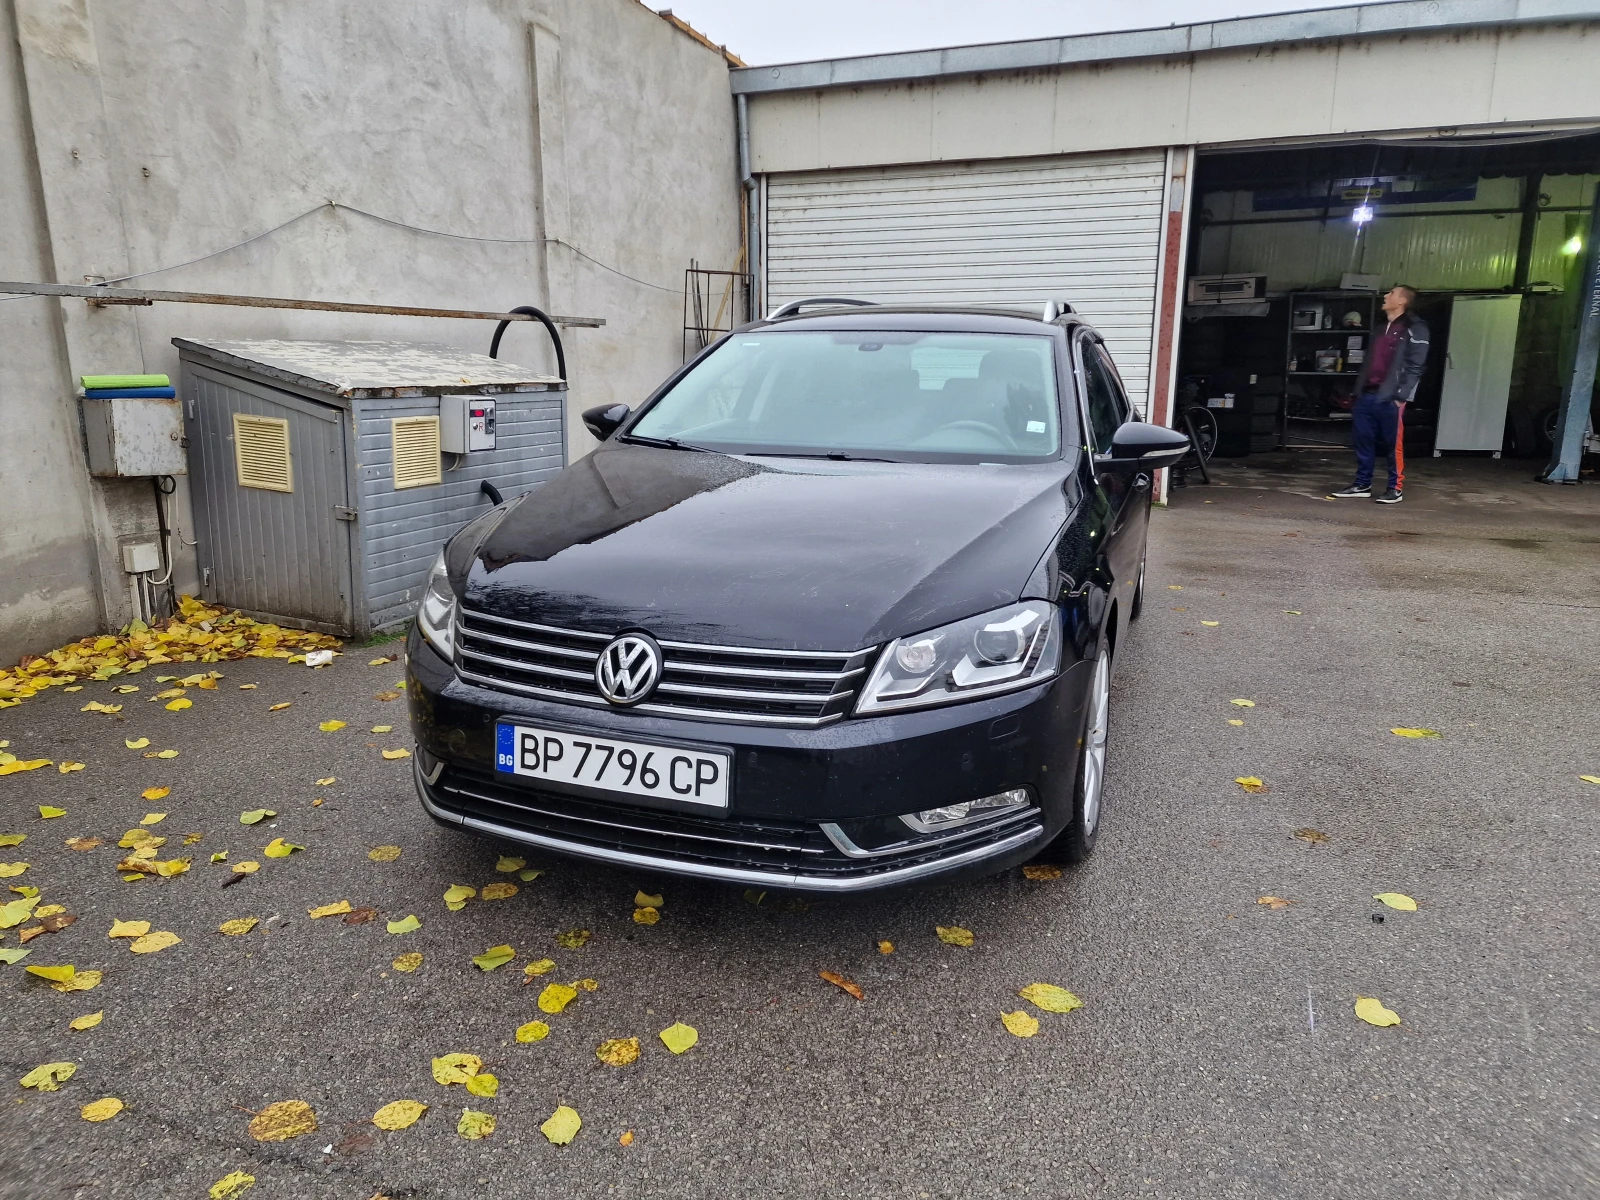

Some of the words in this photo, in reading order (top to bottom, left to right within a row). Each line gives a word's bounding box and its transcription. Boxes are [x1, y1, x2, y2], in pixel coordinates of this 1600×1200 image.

[498, 753, 514, 766] BG
[520, 732, 564, 773] BP
[572, 740, 661, 789] 7796
[669, 755, 719, 797] CP
